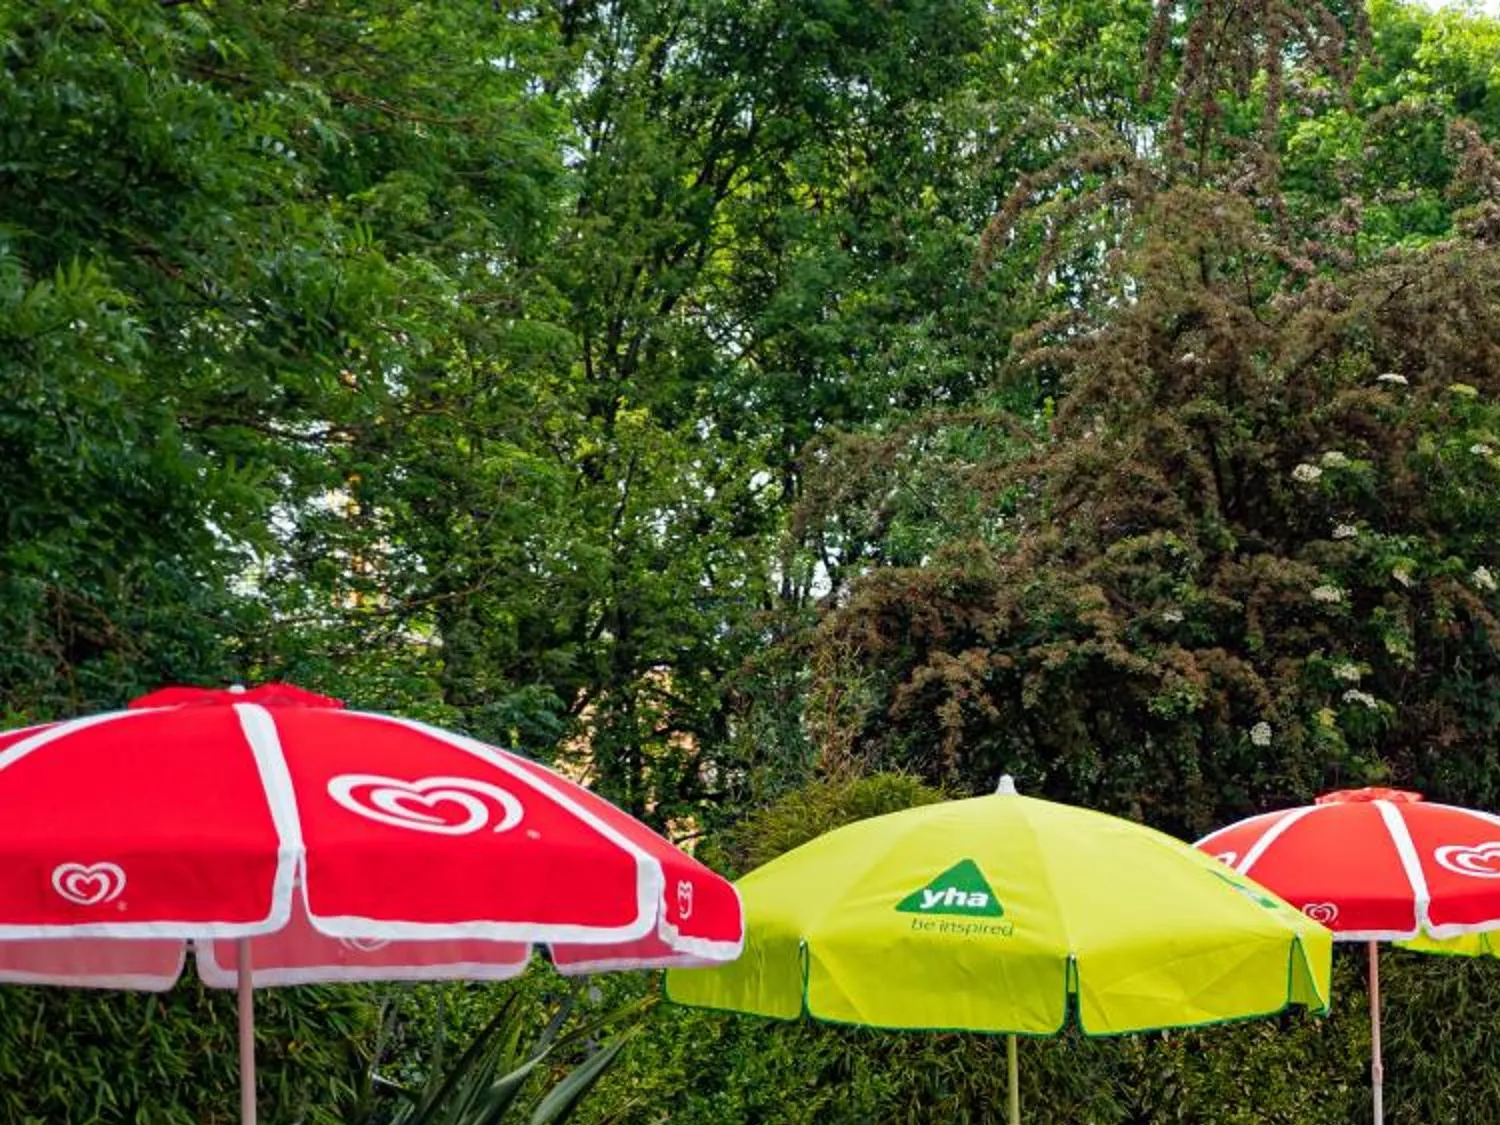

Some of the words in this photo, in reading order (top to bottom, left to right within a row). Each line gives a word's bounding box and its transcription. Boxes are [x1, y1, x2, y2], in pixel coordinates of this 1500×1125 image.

[919, 887, 989, 909] yha
[912, 918, 935, 930] be
[939, 920, 1013, 936] inspired
